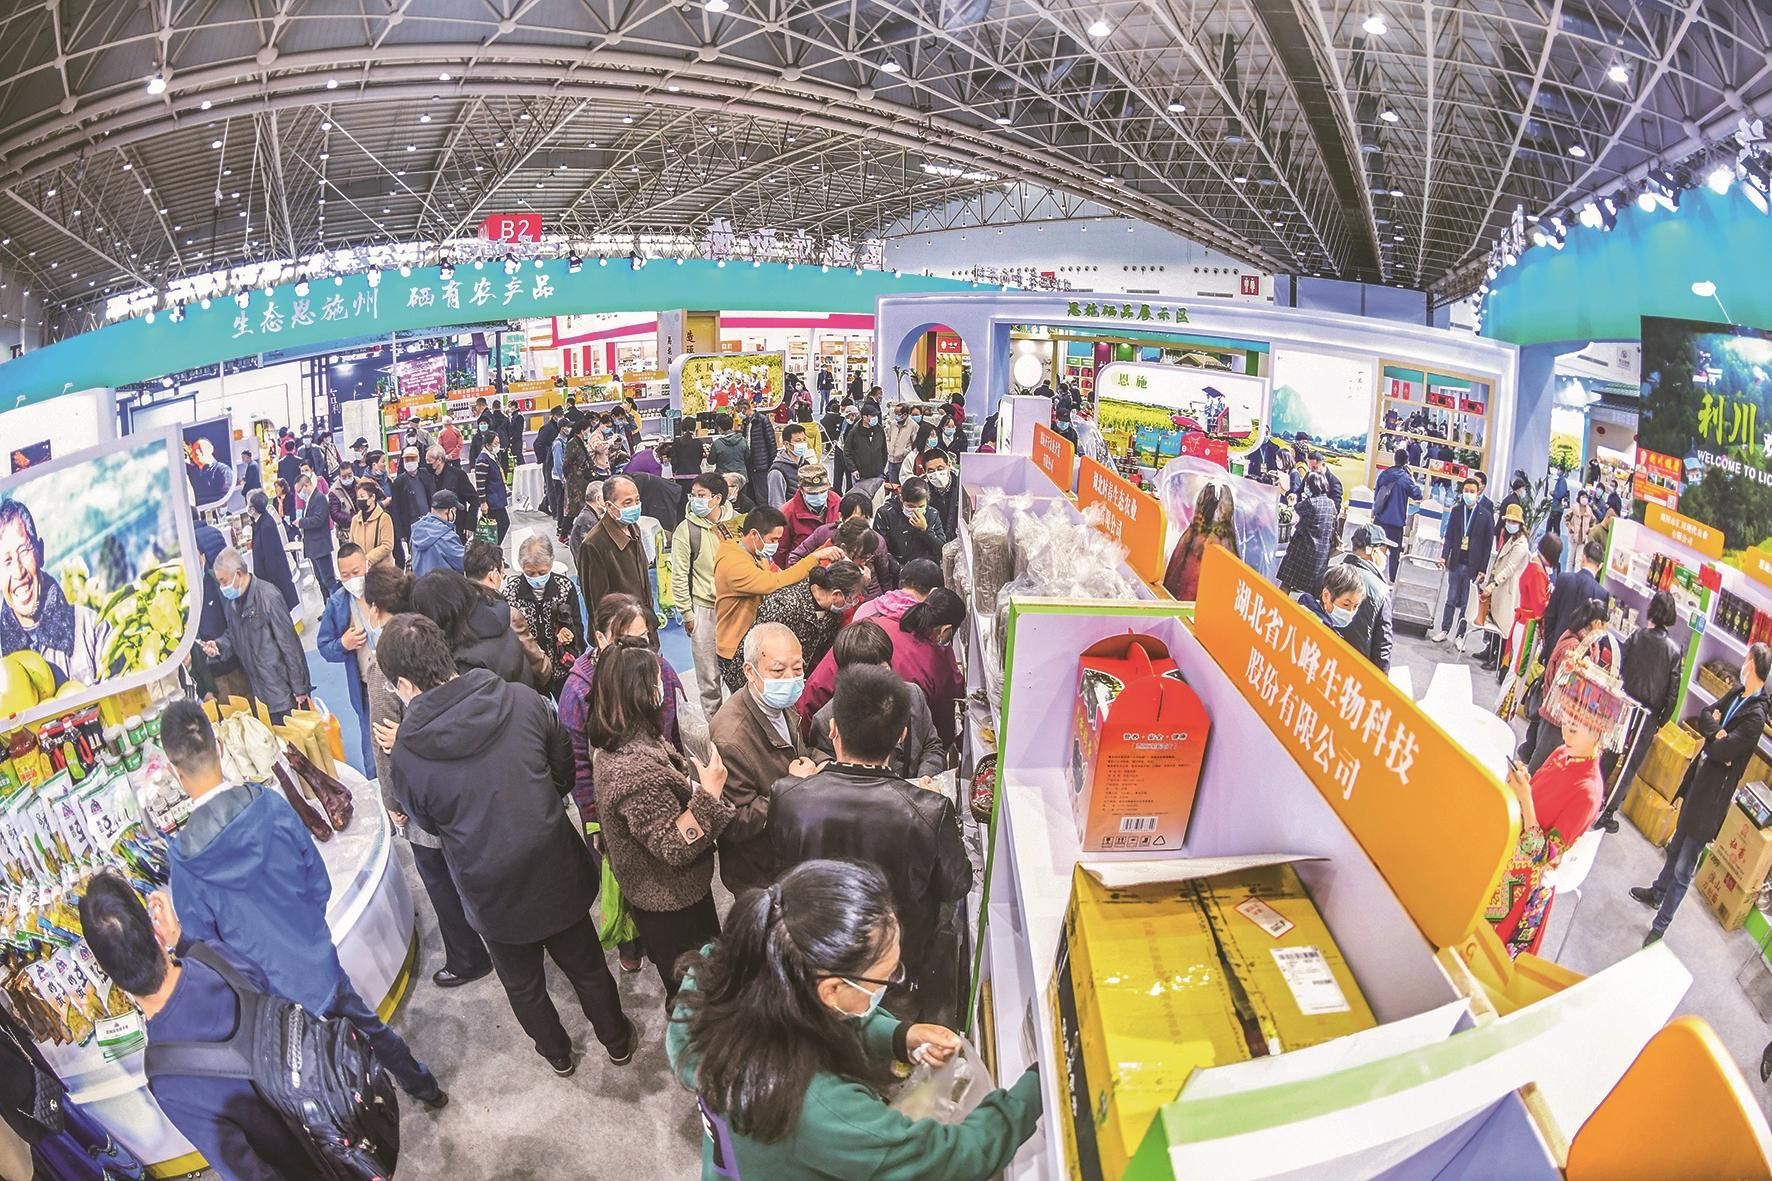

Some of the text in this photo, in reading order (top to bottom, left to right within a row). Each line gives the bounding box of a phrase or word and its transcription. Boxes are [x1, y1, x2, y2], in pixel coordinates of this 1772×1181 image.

[501, 219, 532, 241] B2
[231, 275, 555, 339] 生态恩施州 硒有农产品
[1066, 301, 1189, 323] 恩施硒品展示区
[1117, 373, 1148, 389] 恩施
[1698, 393, 1757, 455] 利川
[1697, 449, 1741, 474] WELCOME
[1743, 465, 1756, 479] TO
[1234, 579, 1420, 785] 湖北省八峰生物科技
[1245, 646, 1361, 800] 股份有限公司
